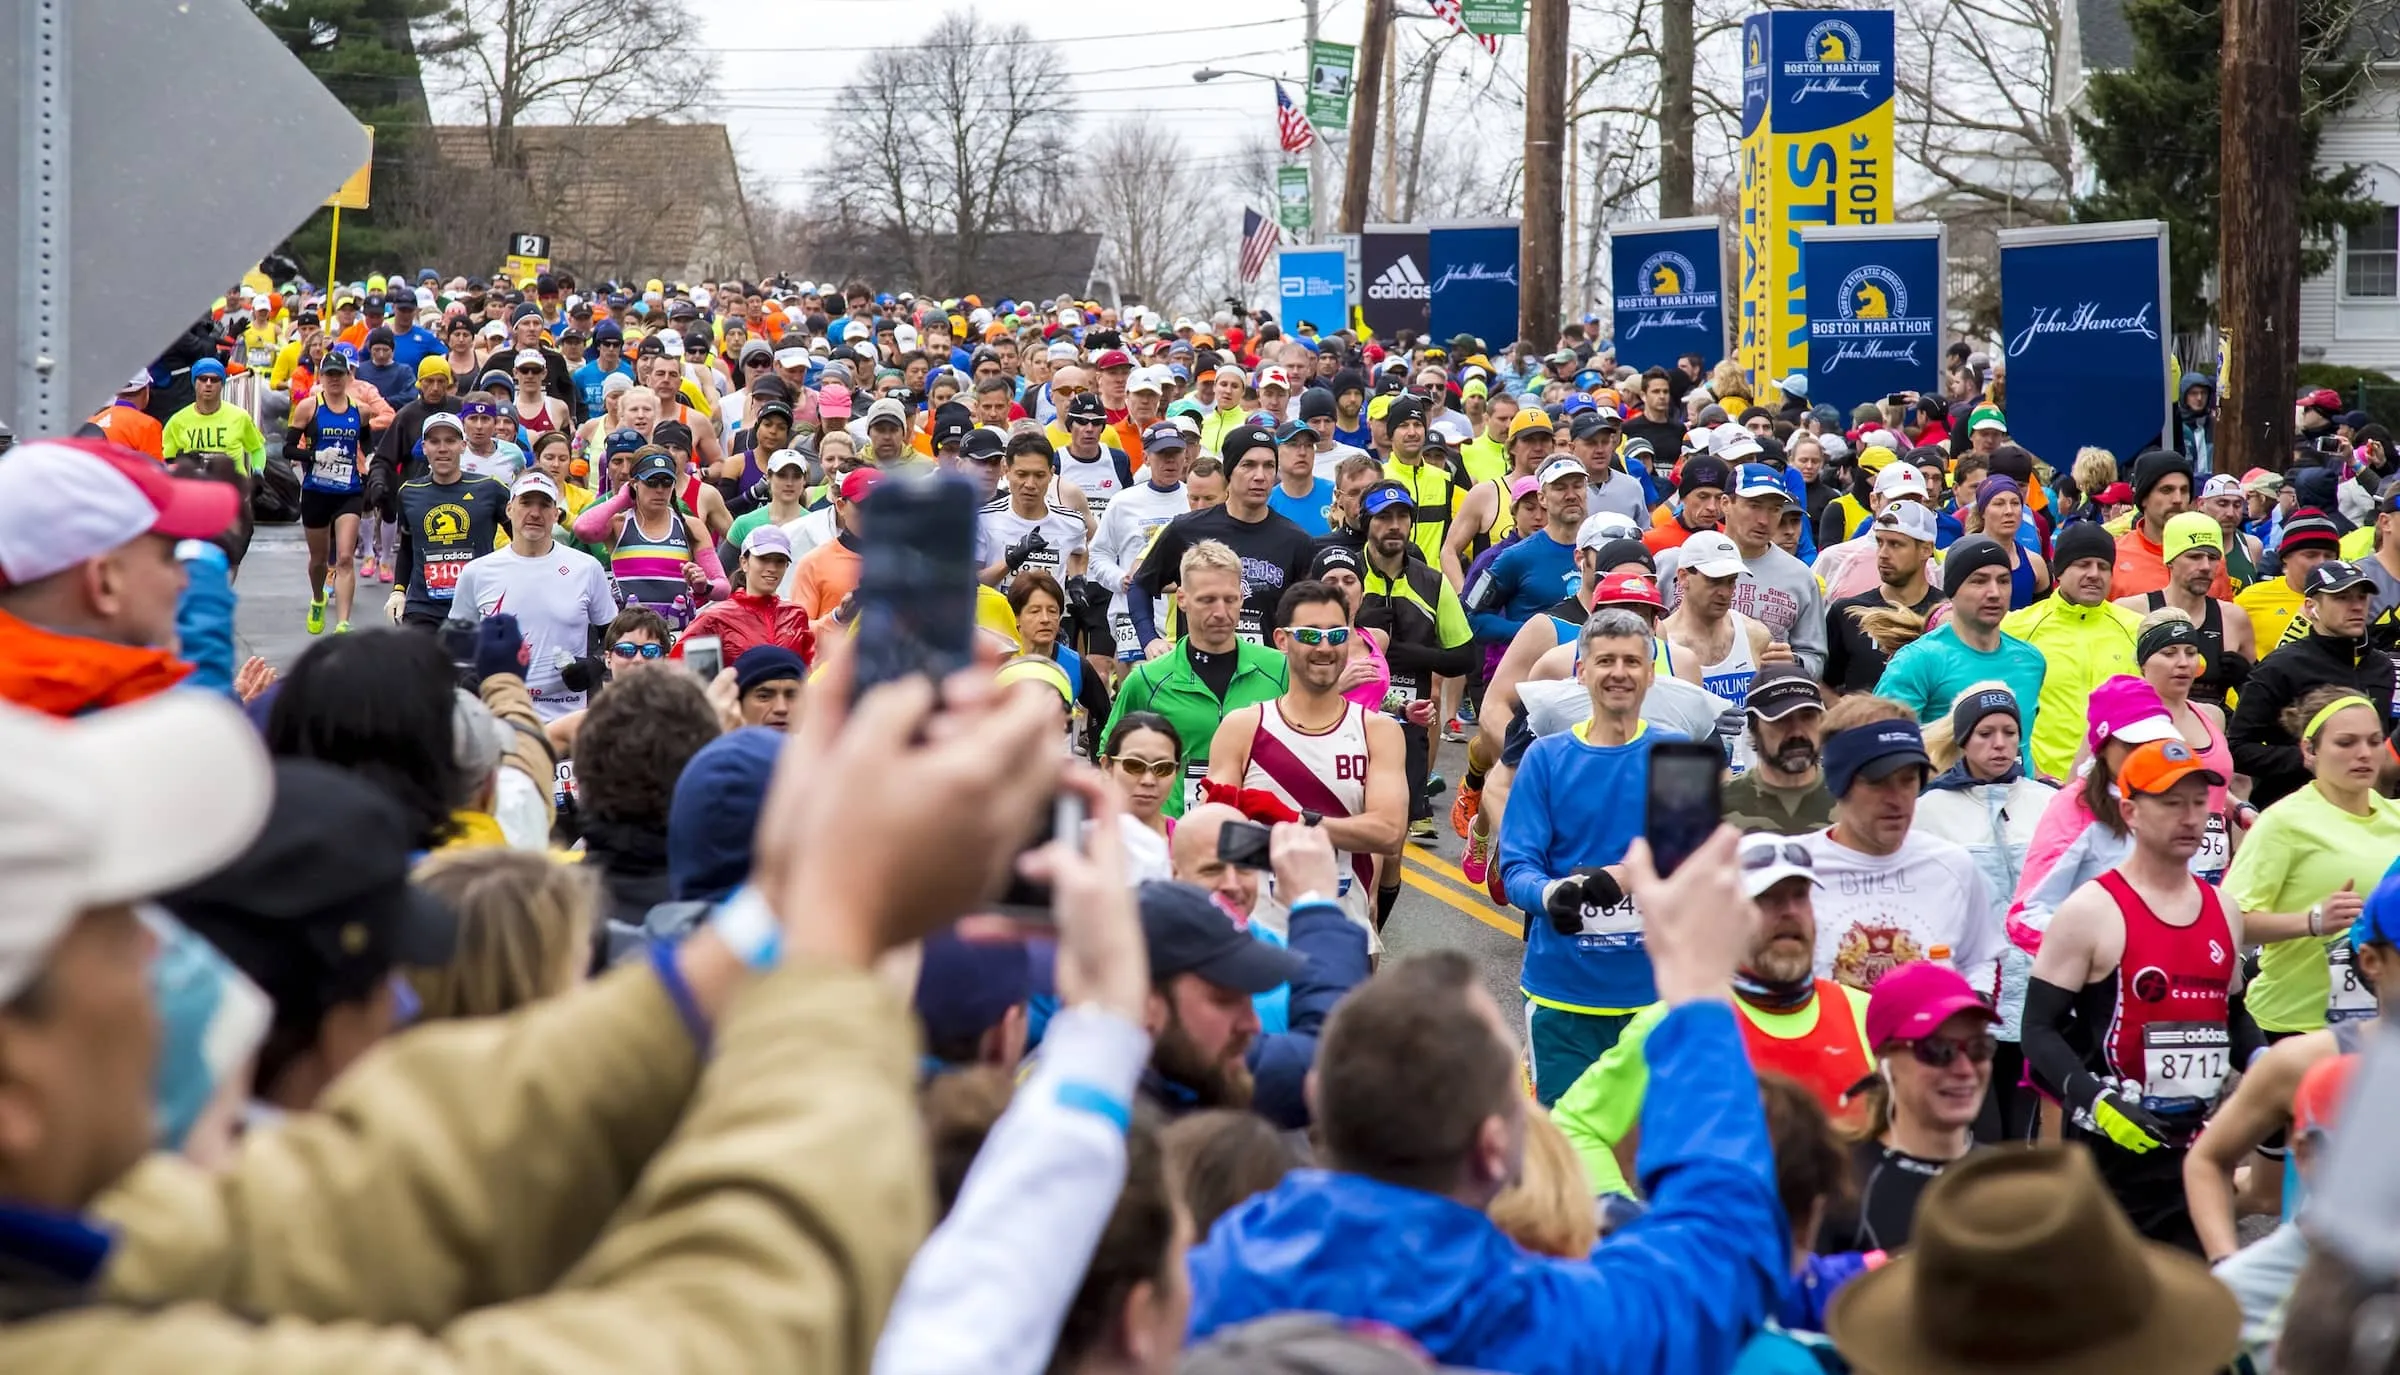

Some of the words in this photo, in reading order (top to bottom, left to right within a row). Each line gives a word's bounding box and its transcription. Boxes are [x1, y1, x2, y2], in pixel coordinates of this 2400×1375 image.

[1784, 63, 1824, 73] BOSTON
[1826, 62, 1880, 73] MARATHON
[1791, 77, 1826, 104] John
[1823, 76, 1872, 100] Hancock
[525, 239, 536, 253] 2
[1432, 263, 1468, 293] John
[1467, 262, 1519, 287] Hancock
[1848, 267, 1881, 287] ATHLETIC
[1368, 283, 1432, 300] adidas
[1617, 297, 1657, 308] BOSTON
[1660, 295, 1716, 306] MARATHON
[1625, 312, 1661, 340] John
[1660, 310, 1709, 332] Hancock
[1812, 321, 1860, 334] BOSTON
[1863, 320, 1931, 333] MARATHON
[2008, 306, 2067, 357] John
[2065, 301, 2159, 340] Hancock
[1822, 340, 1861, 374] John
[1860, 338, 1921, 367] Hancock
[187, 427, 227, 448] YALE
[444, 551, 473, 561] adidas
[429, 563, 462, 580] 310
[1768, 587, 1791, 601] SINCE
[1390, 674, 1416, 685] didas
[527, 688, 542, 696] to
[1336, 754, 1367, 786] BQ
[1839, 868, 1916, 896] BILL
[2184, 1027, 2230, 1044] adidas
[2161, 1052, 2222, 1080] 8712
